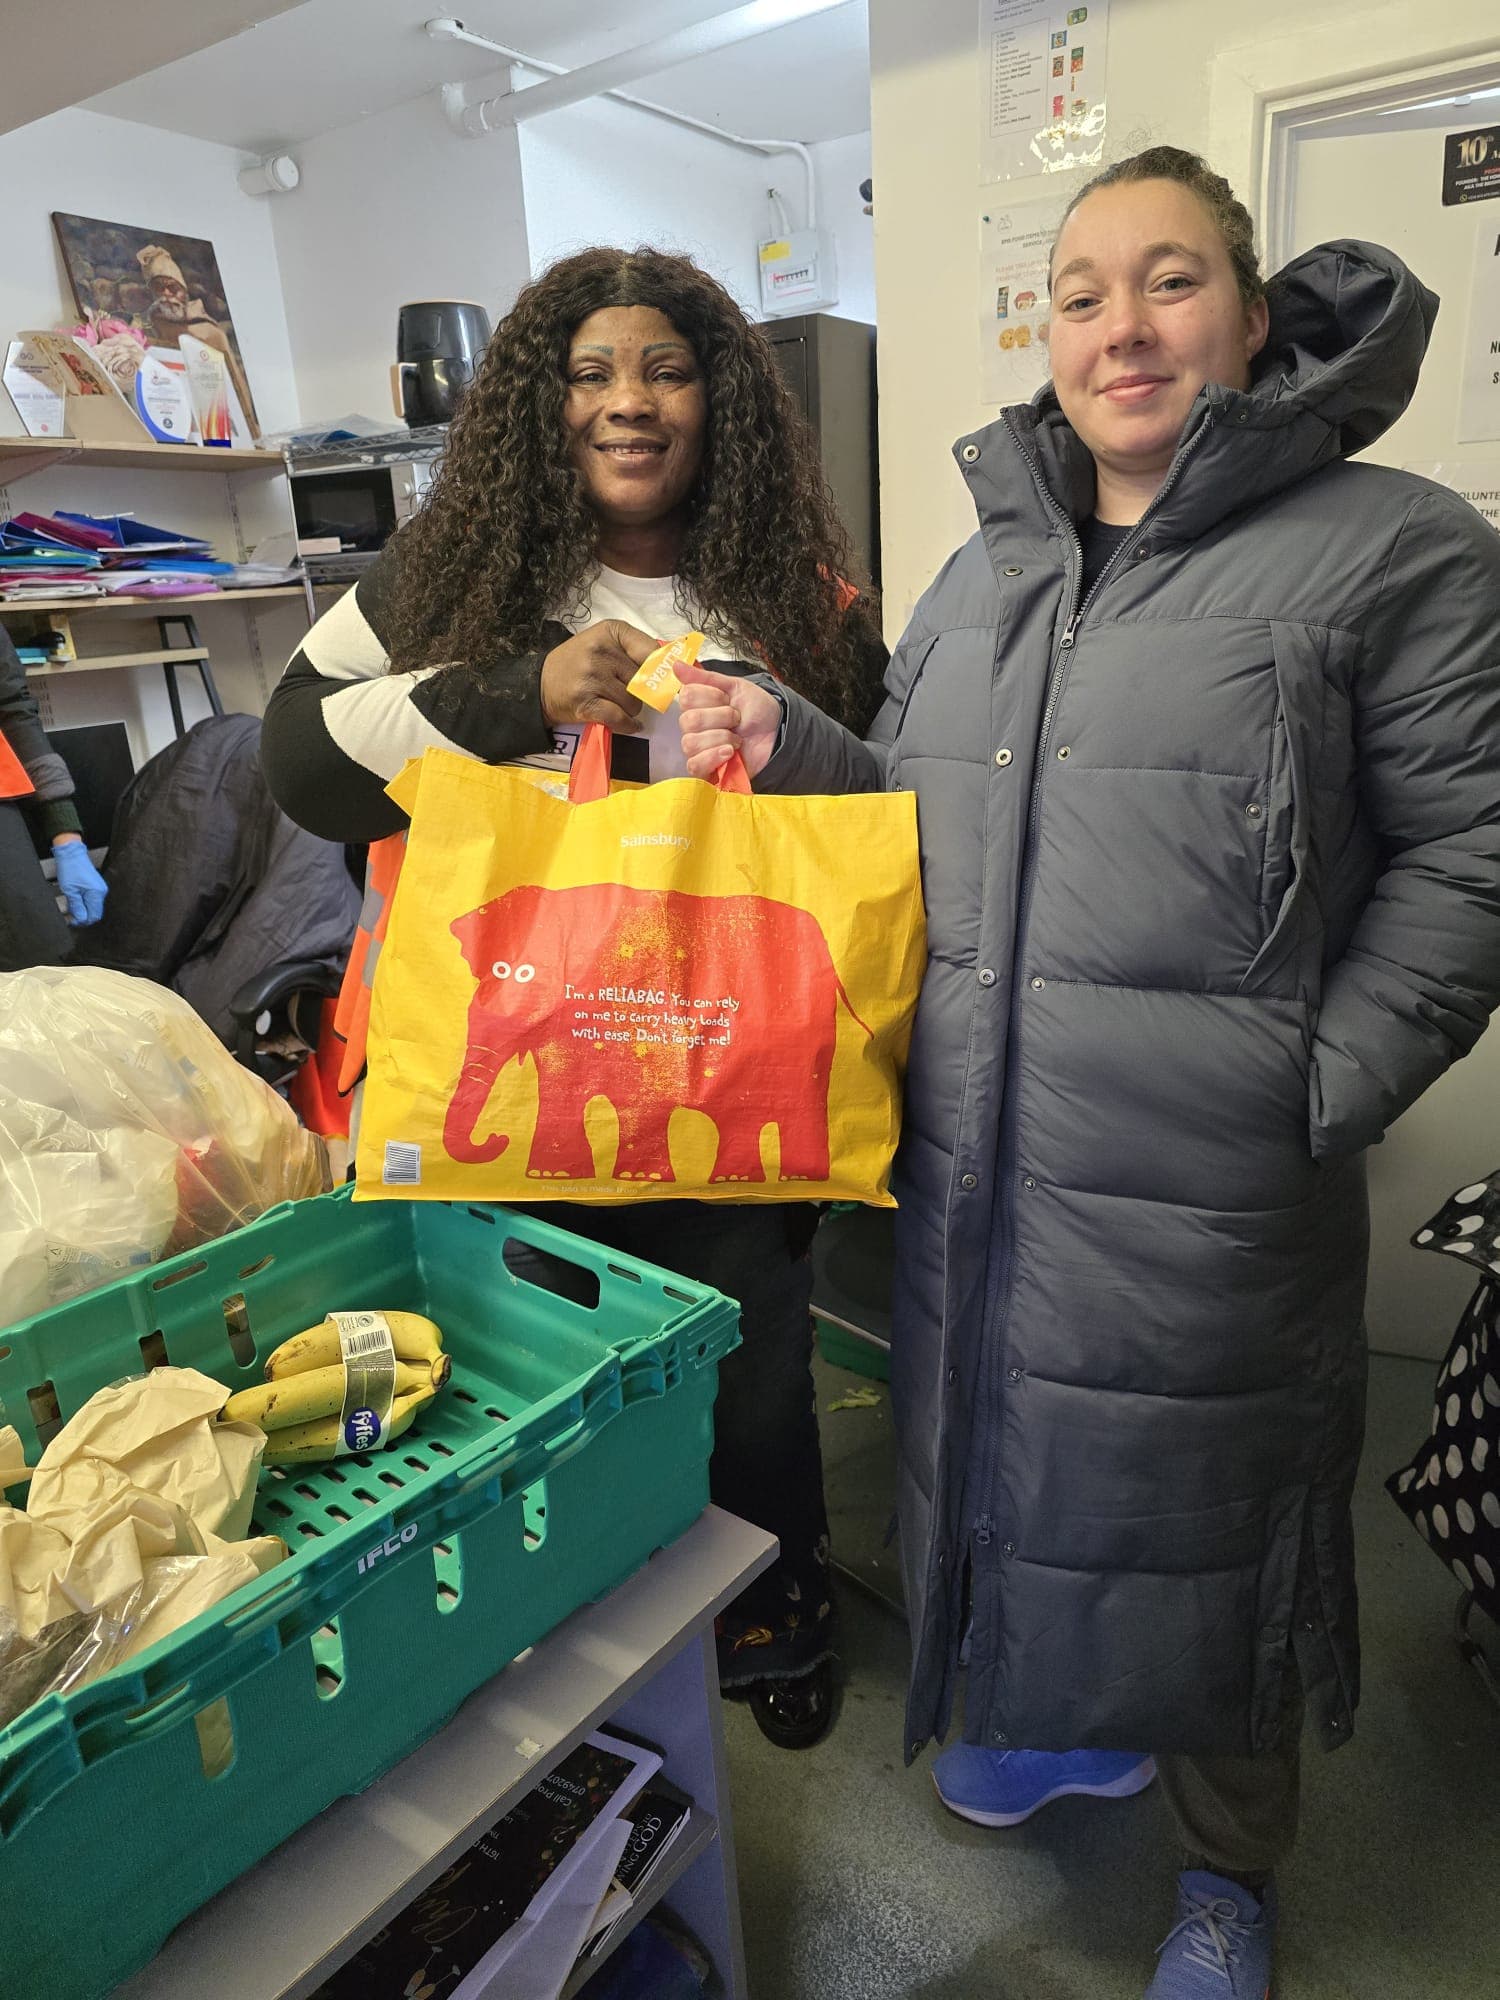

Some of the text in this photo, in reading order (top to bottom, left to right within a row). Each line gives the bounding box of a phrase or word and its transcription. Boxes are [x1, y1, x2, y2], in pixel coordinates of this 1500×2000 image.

[565, 984, 585, 1000] I'm
[588, 992, 595, 1001] a
[671, 993, 691, 1007] You
[693, 999, 713, 1009] can
[716, 996, 740, 1013] rely
[574, 1010, 730, 1030] on me to carry heavy loads
[571, 1026, 601, 1040] with
[636, 1028, 669, 1044] Don't
[671, 1029, 706, 1049] forget
[708, 1029, 731, 1046] me!
[358, 1523, 418, 1575] IFCO
[552, 1793, 573, 1807] Call
[633, 1817, 662, 1853] GOD
